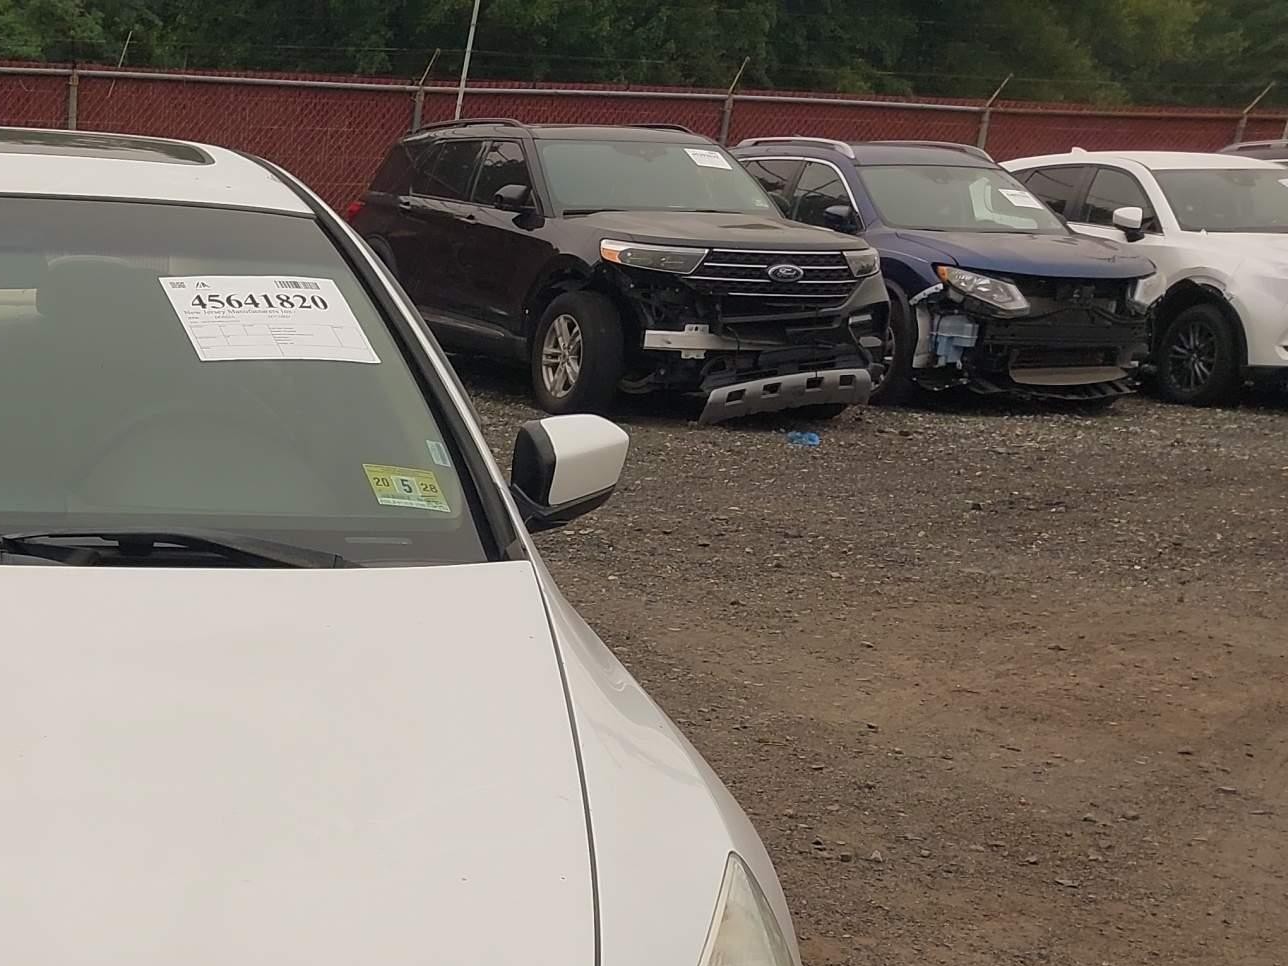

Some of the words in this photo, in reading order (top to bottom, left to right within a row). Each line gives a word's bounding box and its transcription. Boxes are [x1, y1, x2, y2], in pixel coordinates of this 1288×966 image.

[191, 293, 328, 310] 45641820
[373, 476, 390, 487] 20
[399, 479, 413, 494] 5
[420, 482, 438, 494] 28
